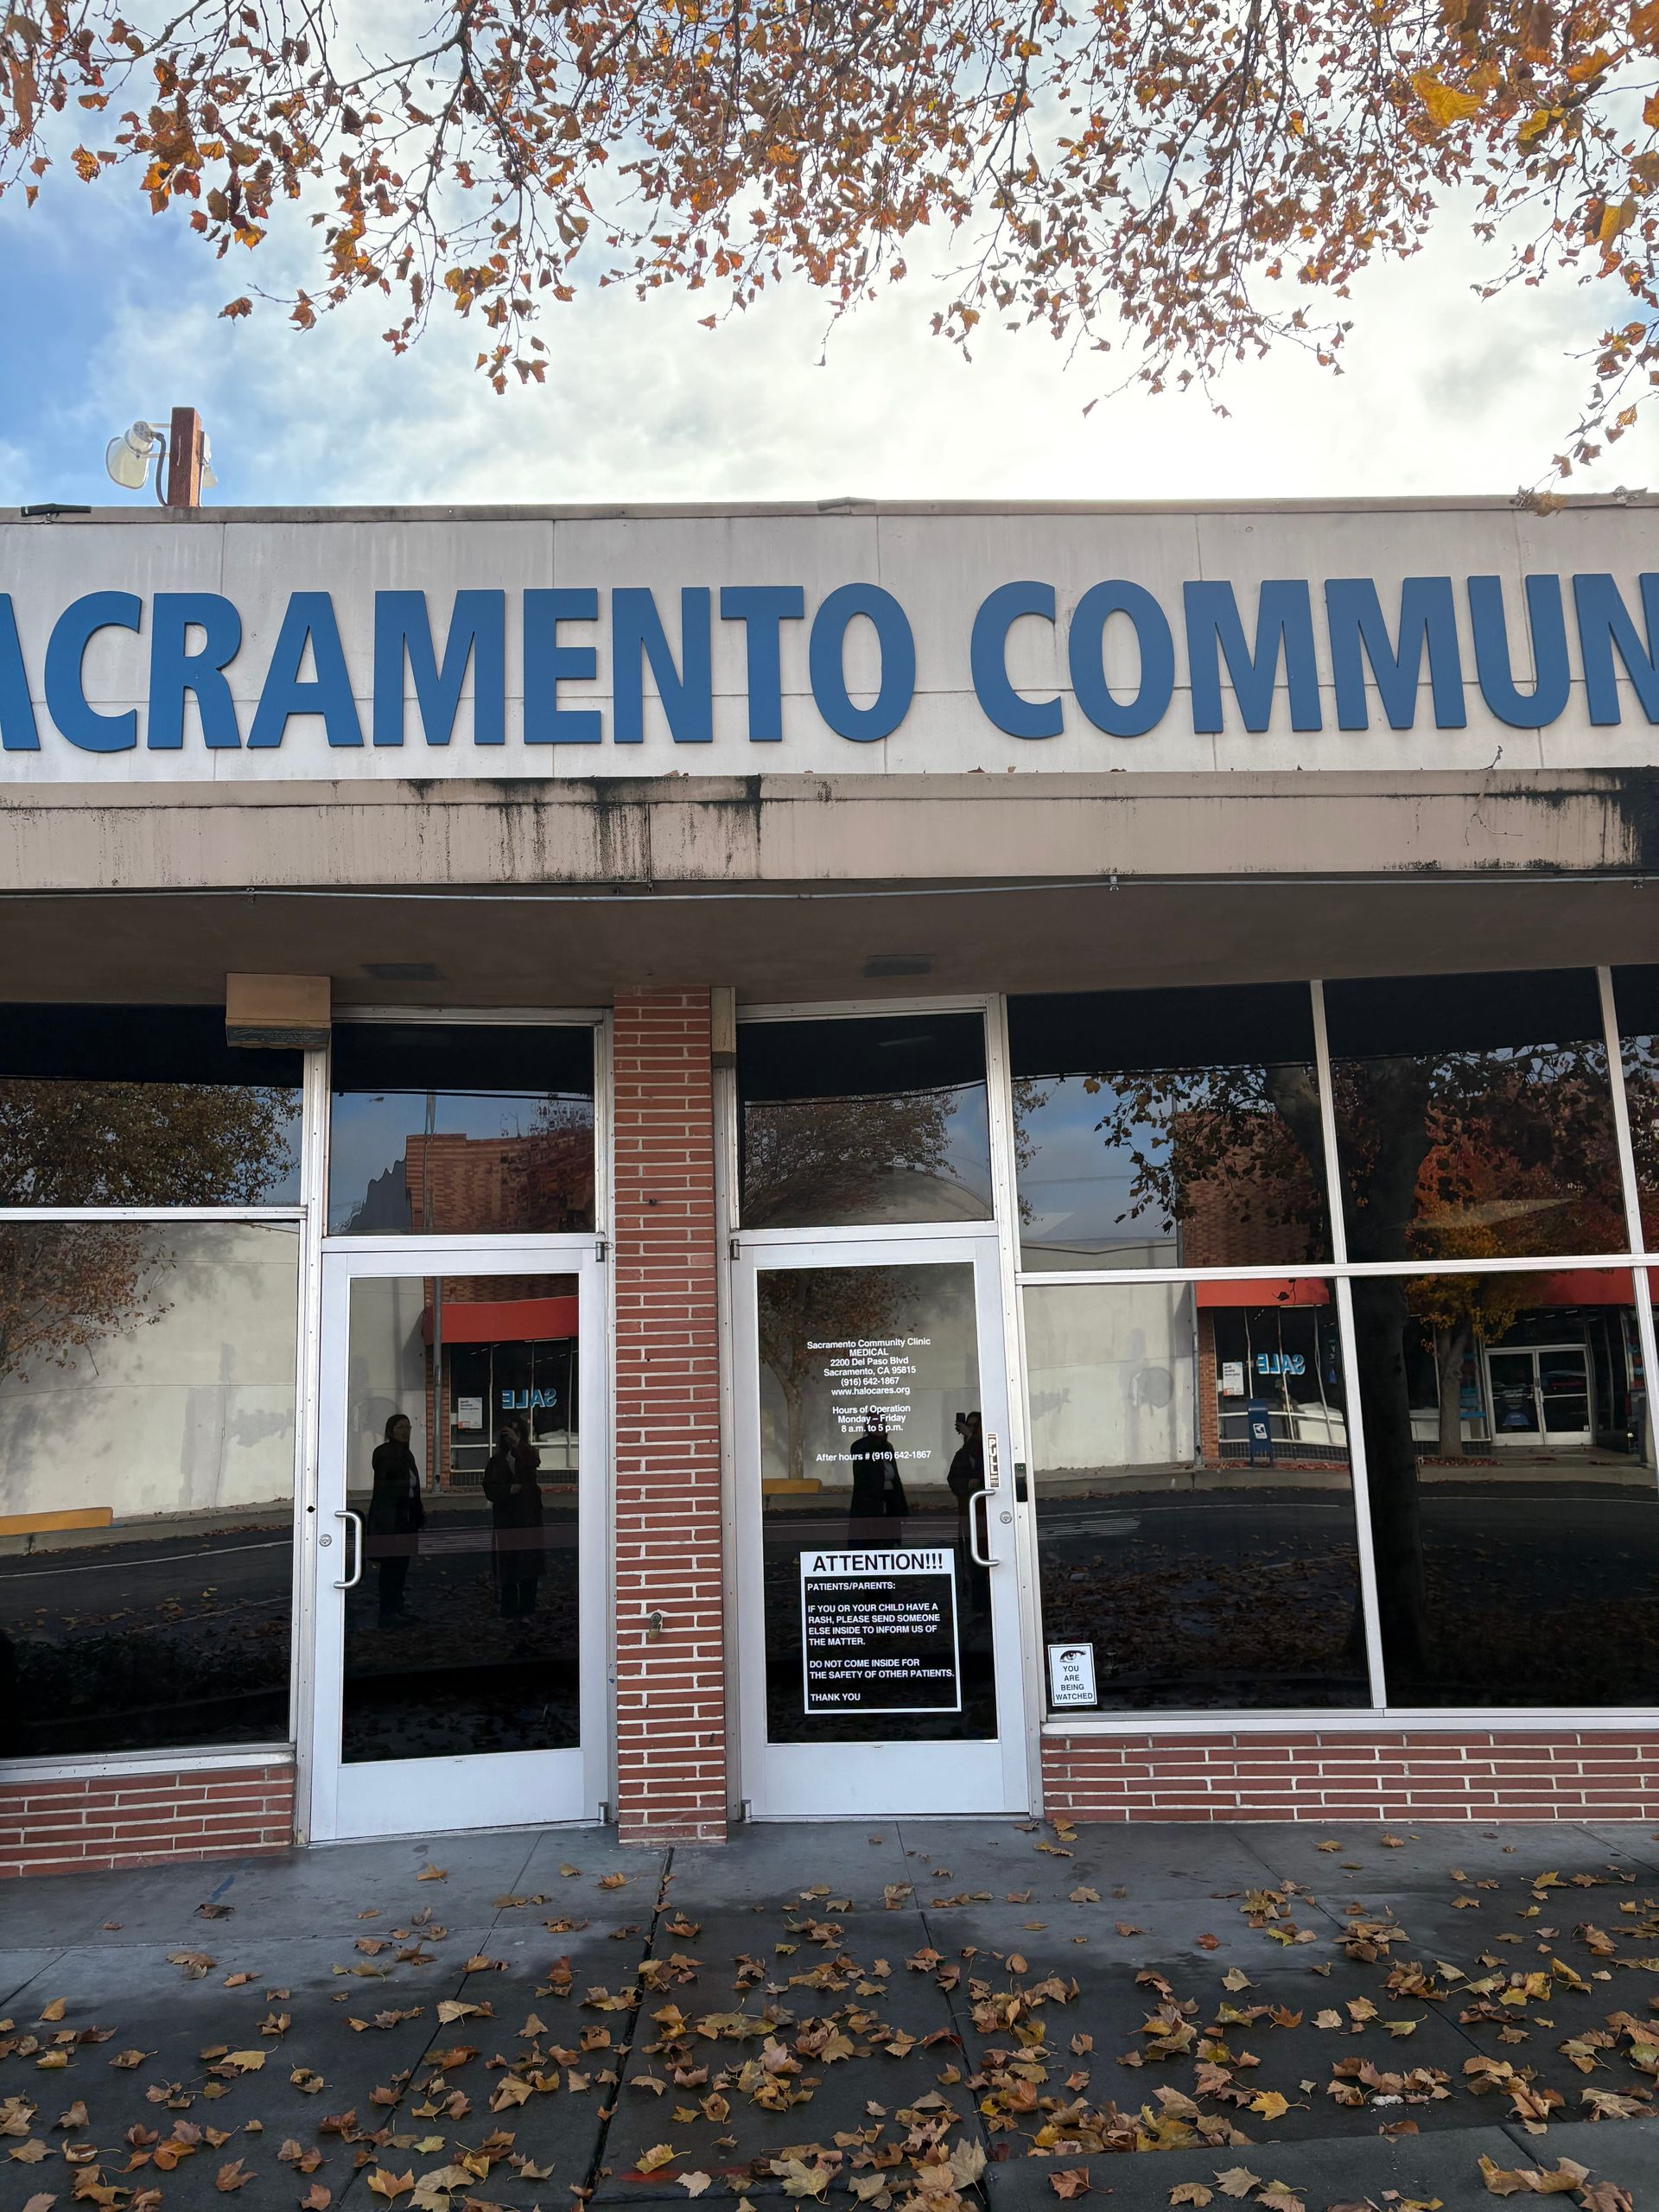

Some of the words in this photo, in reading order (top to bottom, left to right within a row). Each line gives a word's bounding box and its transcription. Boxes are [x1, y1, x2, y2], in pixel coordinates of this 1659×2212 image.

[970, 574, 1659, 740] COMMUN
[807, 1340, 855, 1349] Sacramento
[858, 1338, 905, 1348] Community
[823, 1368, 875, 1376] Sacramento,
[841, 1378, 861, 1387] (916)
[831, 1387, 910, 1395] www.halocares.org
[870, 1405, 910, 1414] Operation
[838, 1415, 871, 1424] Monday
[872, 1452, 893, 1461] (916)
[988, 1439, 998, 1474] PULL
[813, 1554, 943, 1572] ATTENTION!!!
[808, 1582, 895, 1591] PATIENTS/PARENTS:
[809, 1616, 835, 1624] RASH,
